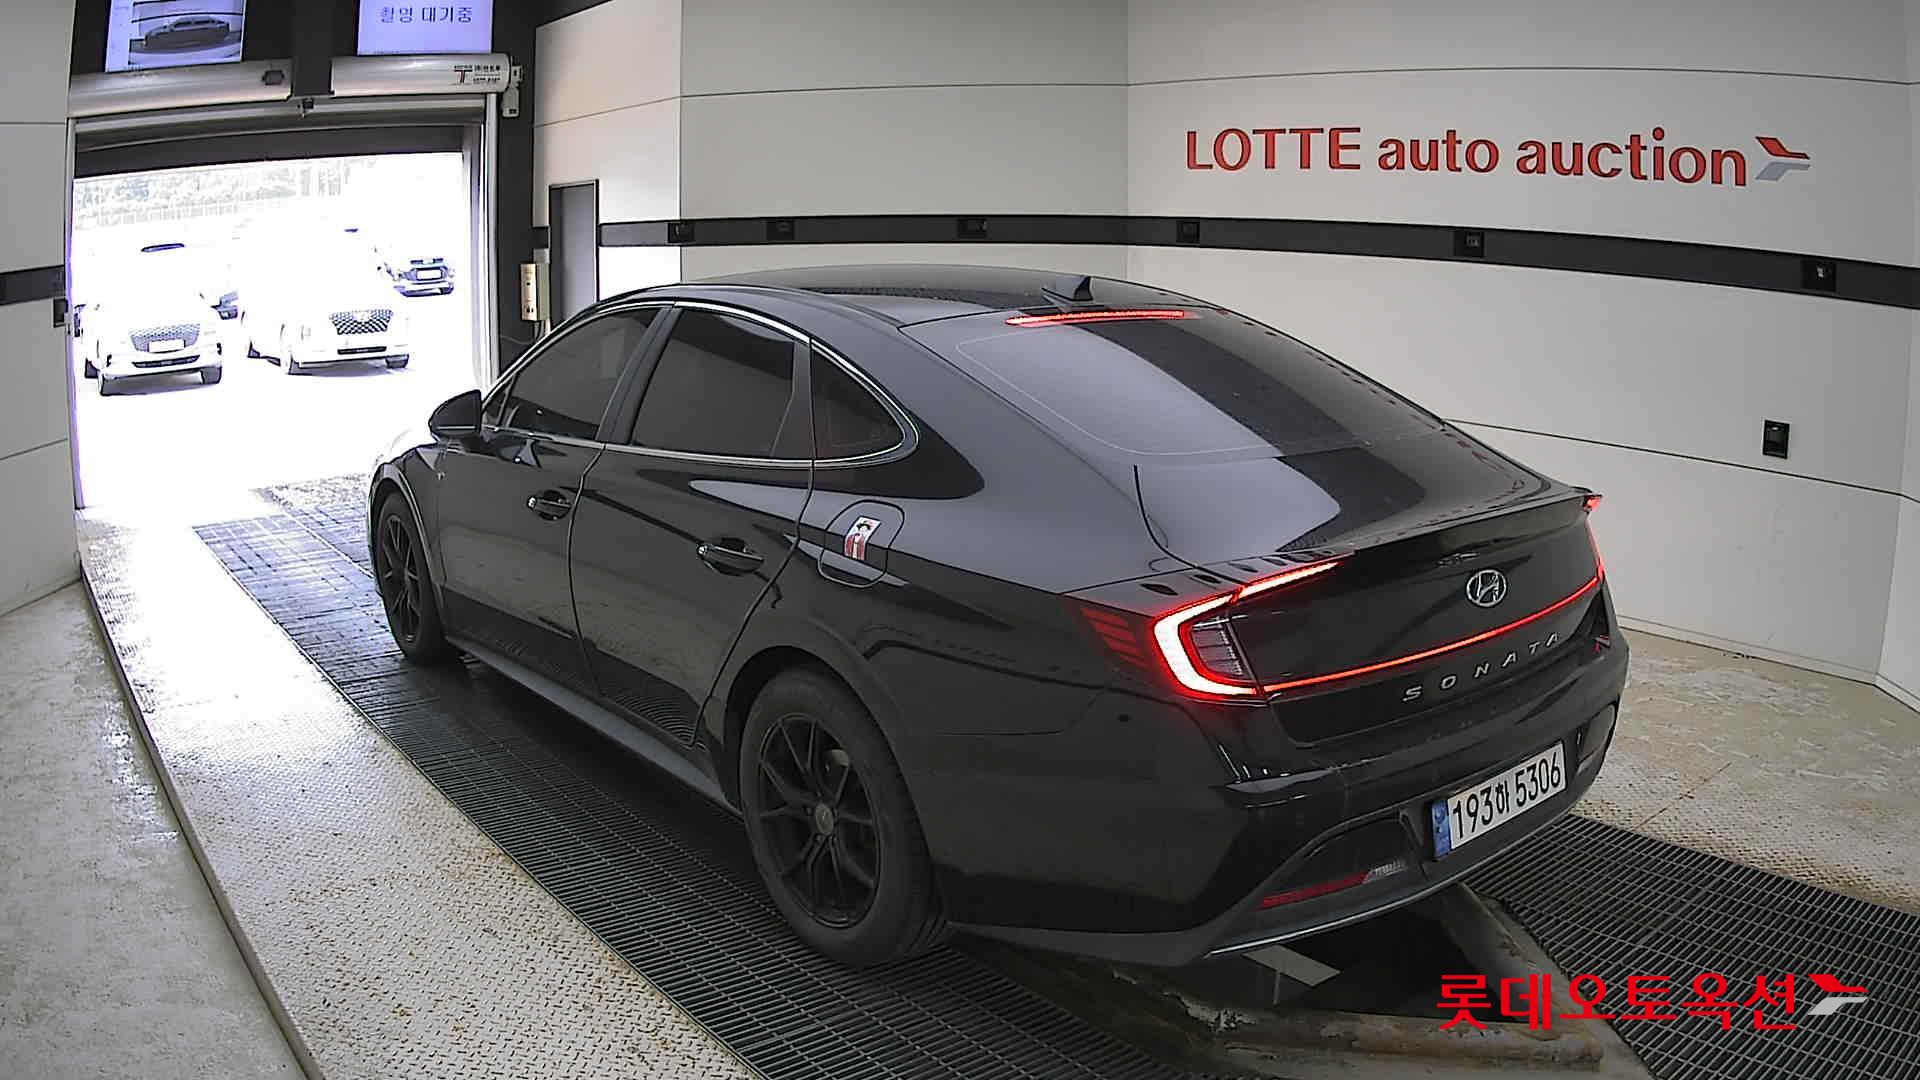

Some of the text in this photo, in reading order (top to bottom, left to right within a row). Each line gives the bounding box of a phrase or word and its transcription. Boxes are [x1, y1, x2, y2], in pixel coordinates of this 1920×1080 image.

[421, 5, 473, 24] 대기중
[1187, 127, 1747, 187] LOTTE auto auction
[1402, 632, 1560, 702] SONATA
[1452, 750, 1562, 840] 193하 5306
